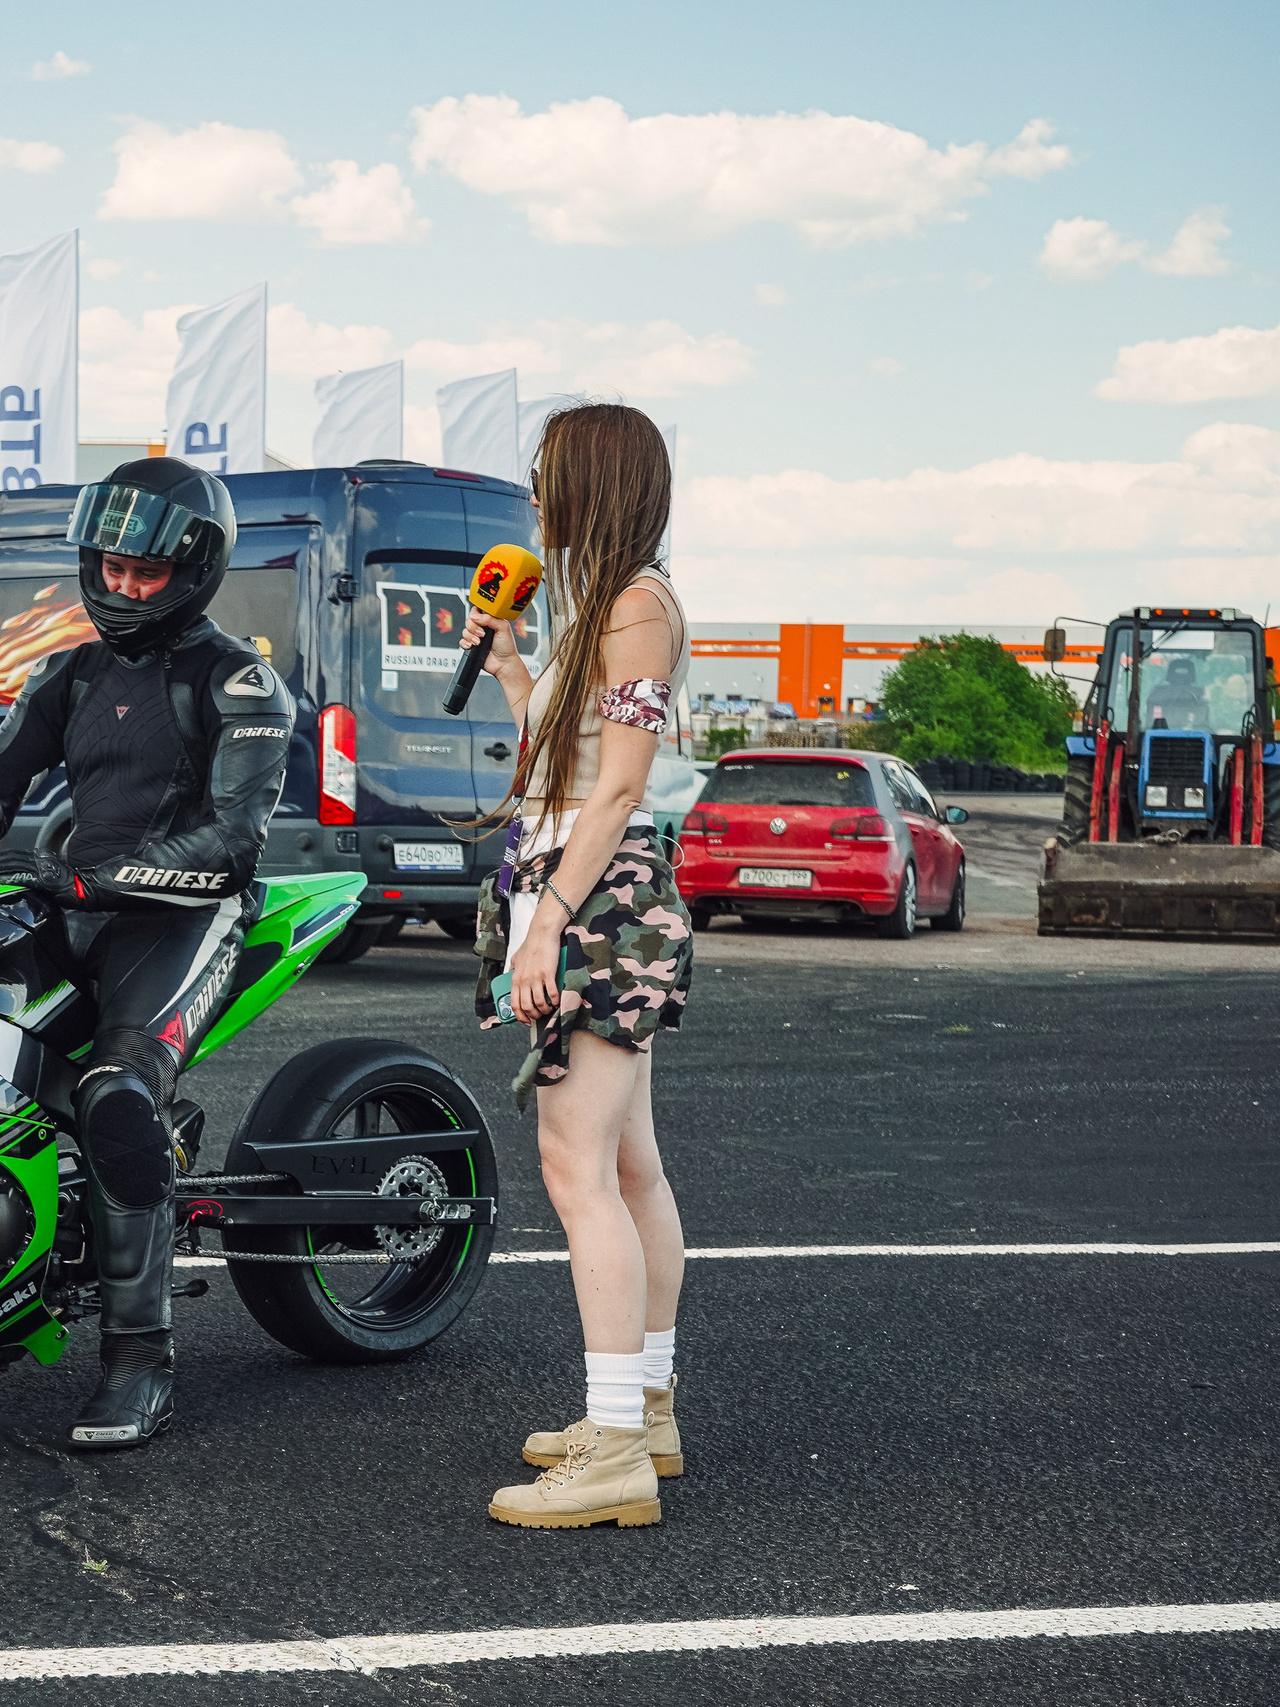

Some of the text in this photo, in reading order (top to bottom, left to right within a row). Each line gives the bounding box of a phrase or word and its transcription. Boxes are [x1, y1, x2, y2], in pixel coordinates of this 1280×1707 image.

[384, 654, 424, 666] RUSSIAN
[426, 656, 449, 668] DRAG
[311, 1155, 376, 1175] EVIL
